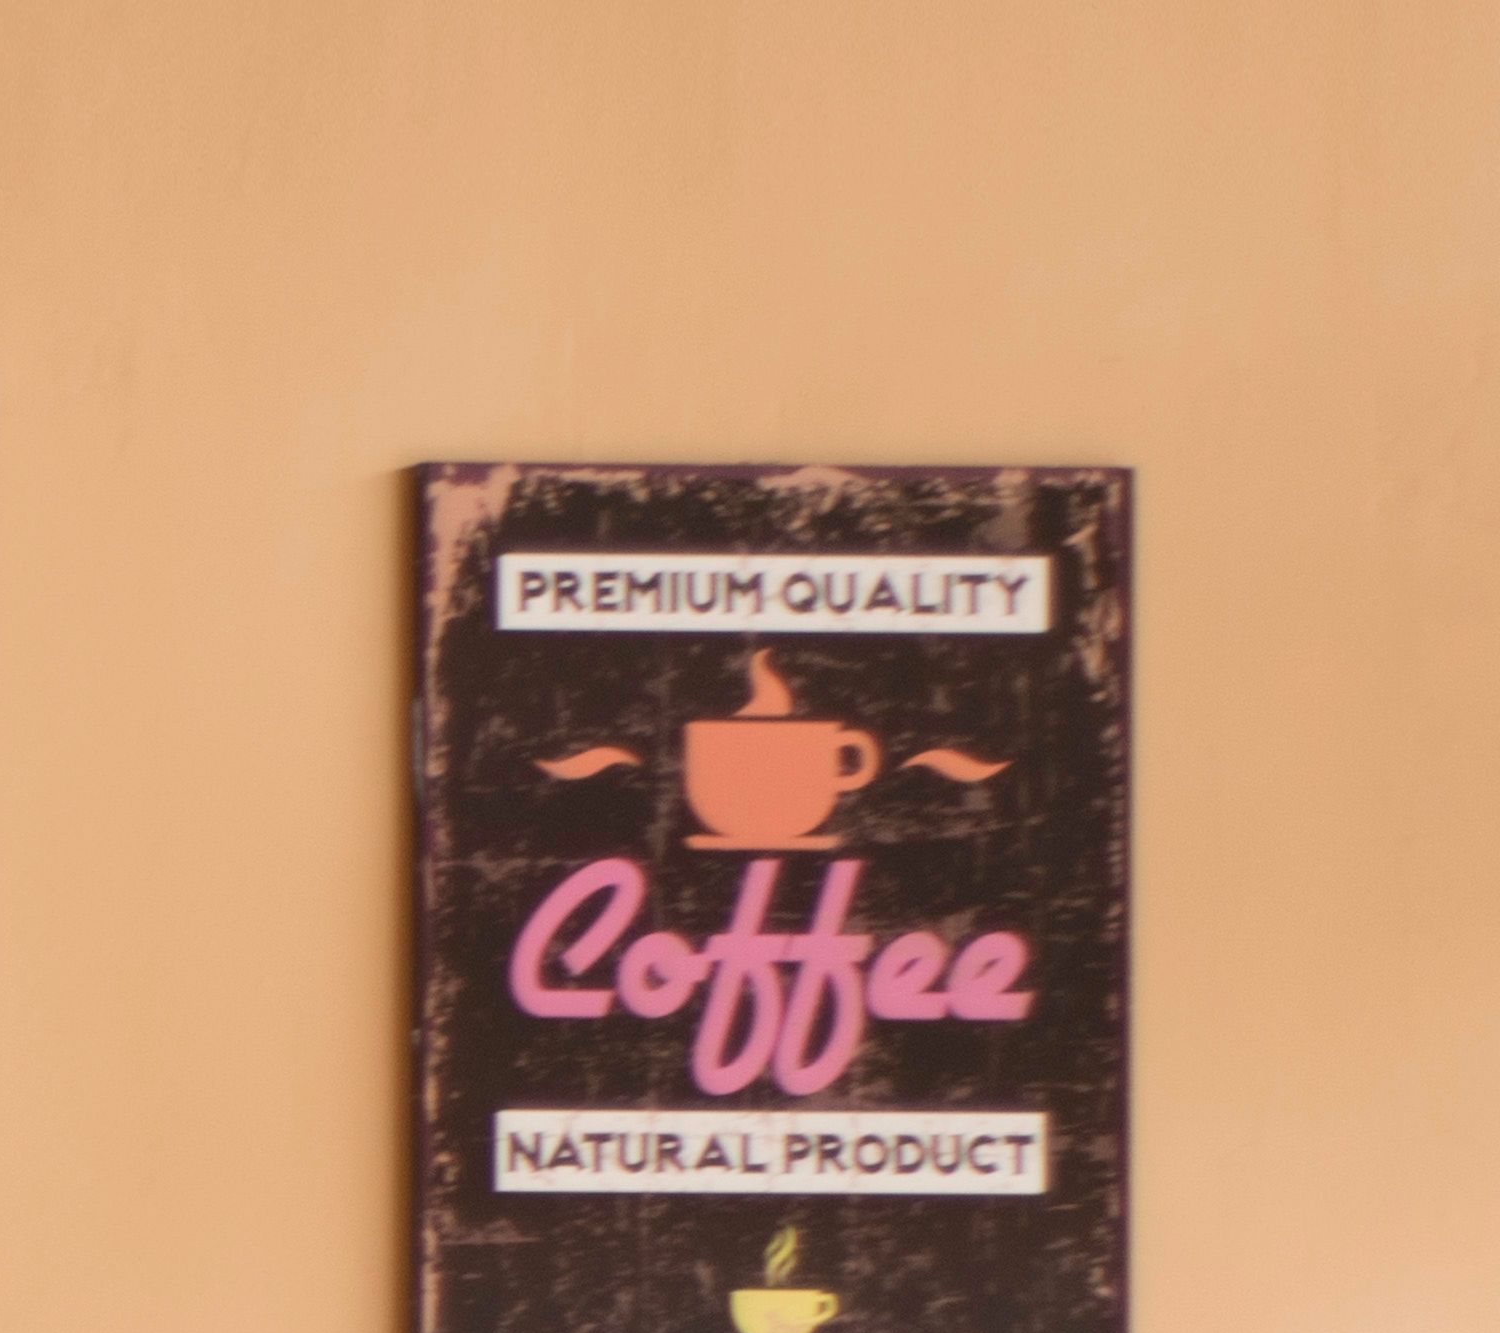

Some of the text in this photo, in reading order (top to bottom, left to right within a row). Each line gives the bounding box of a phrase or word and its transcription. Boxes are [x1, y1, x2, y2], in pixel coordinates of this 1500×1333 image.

[520, 570, 1027, 616] PREMIUM QUALITY
[509, 856, 1035, 1097] Coffee
[506, 1132, 1035, 1175] NATURAL PRODUCT
